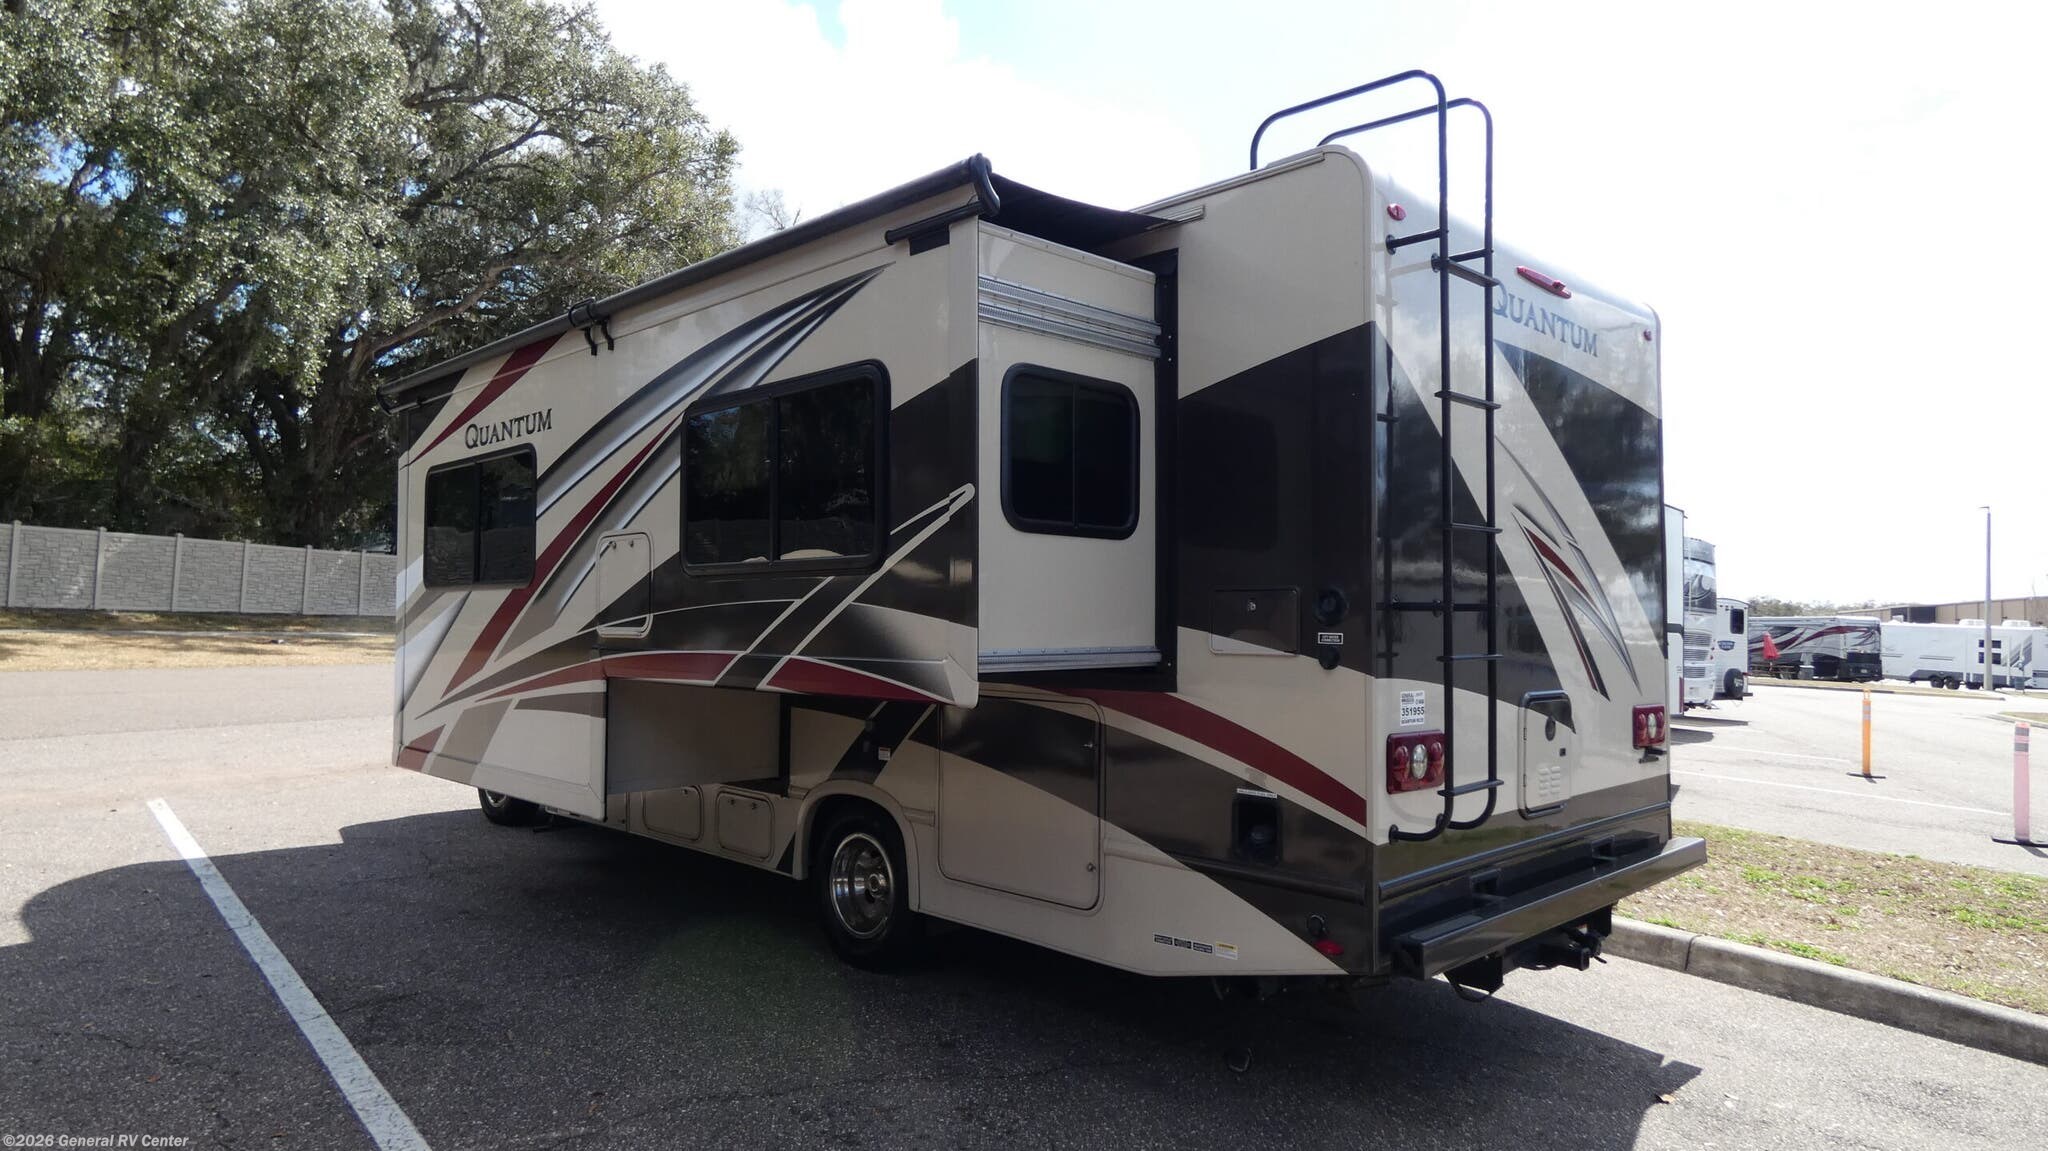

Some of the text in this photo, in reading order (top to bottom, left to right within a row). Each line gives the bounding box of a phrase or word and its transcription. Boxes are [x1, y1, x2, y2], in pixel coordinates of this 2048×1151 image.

[1493, 279, 1598, 358] QUANTUM
[465, 408, 552, 449] QUANTUM
[1401, 707, 1425, 716] 351955
